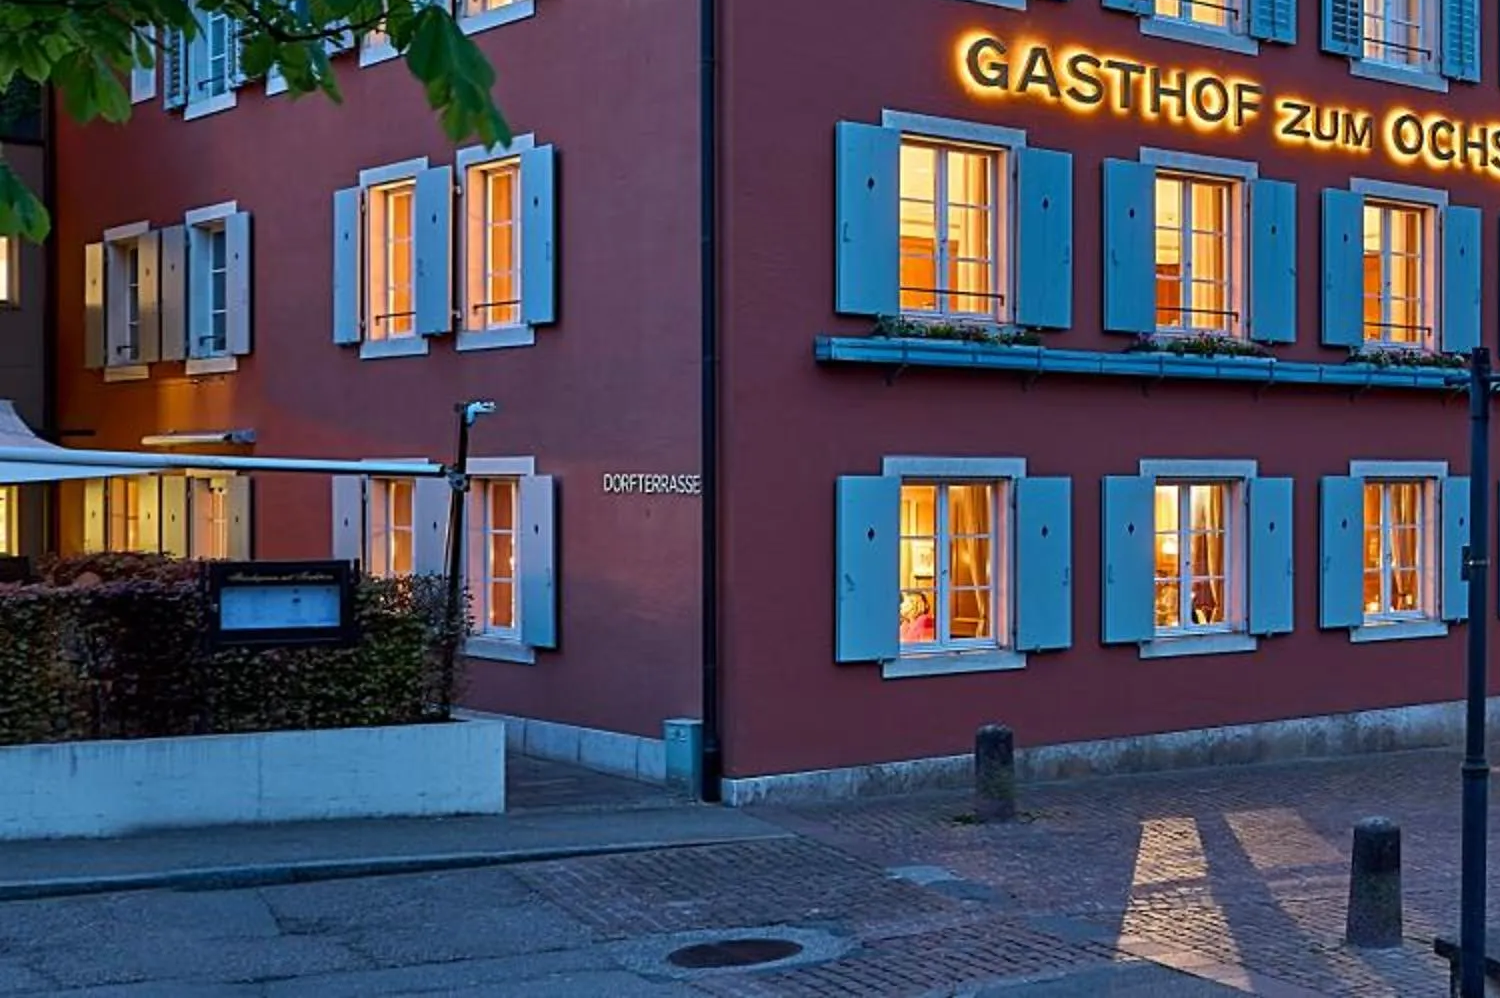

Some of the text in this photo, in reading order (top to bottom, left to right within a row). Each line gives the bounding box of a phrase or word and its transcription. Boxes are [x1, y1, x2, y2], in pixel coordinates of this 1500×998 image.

[965, 36, 1263, 128] GASTHOF
[1281, 100, 1374, 149] ZUM
[603, 473, 702, 493] DORFTERRASSE
